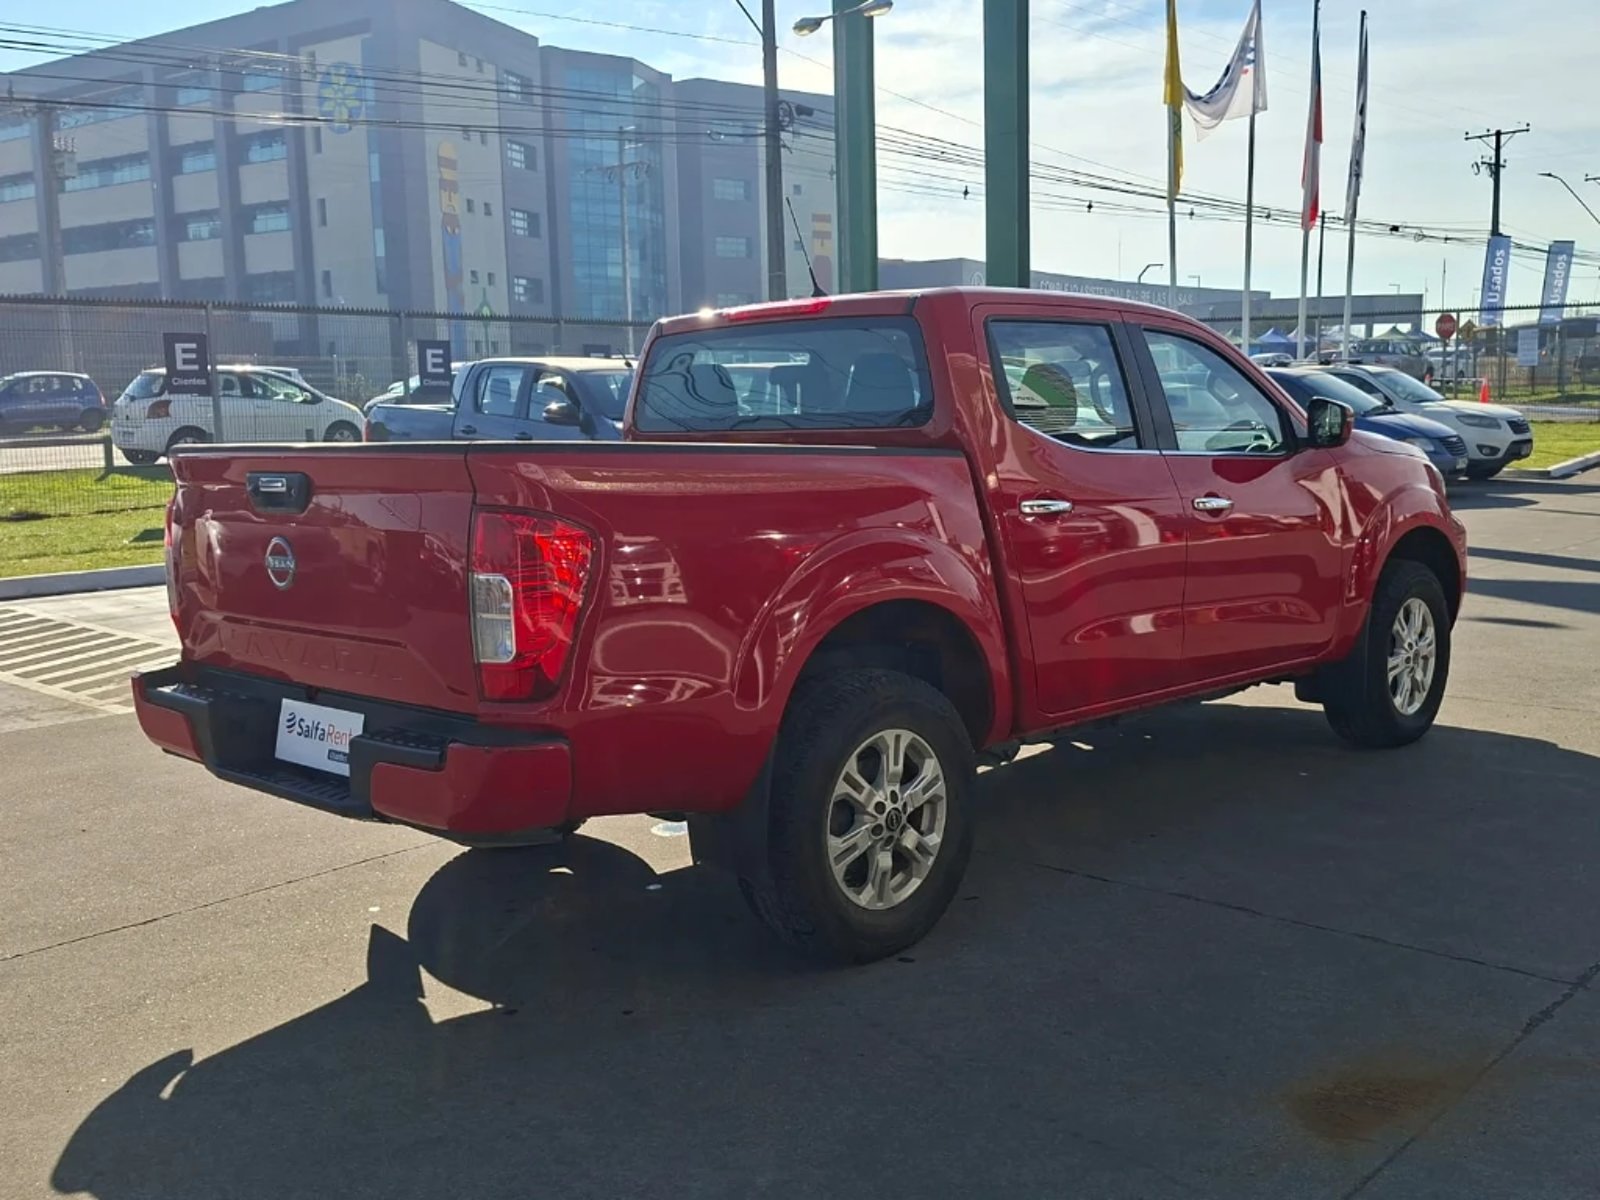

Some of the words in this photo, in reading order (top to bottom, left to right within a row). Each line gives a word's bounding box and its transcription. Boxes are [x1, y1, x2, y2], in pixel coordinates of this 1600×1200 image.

[1486, 249, 1506, 303] Usados
[1548, 254, 1567, 304] Usados
[174, 343, 199, 371] E
[426, 349, 445, 373] E
[171, 376, 208, 386] Clientes
[297, 718, 353, 746] SalfaRent
